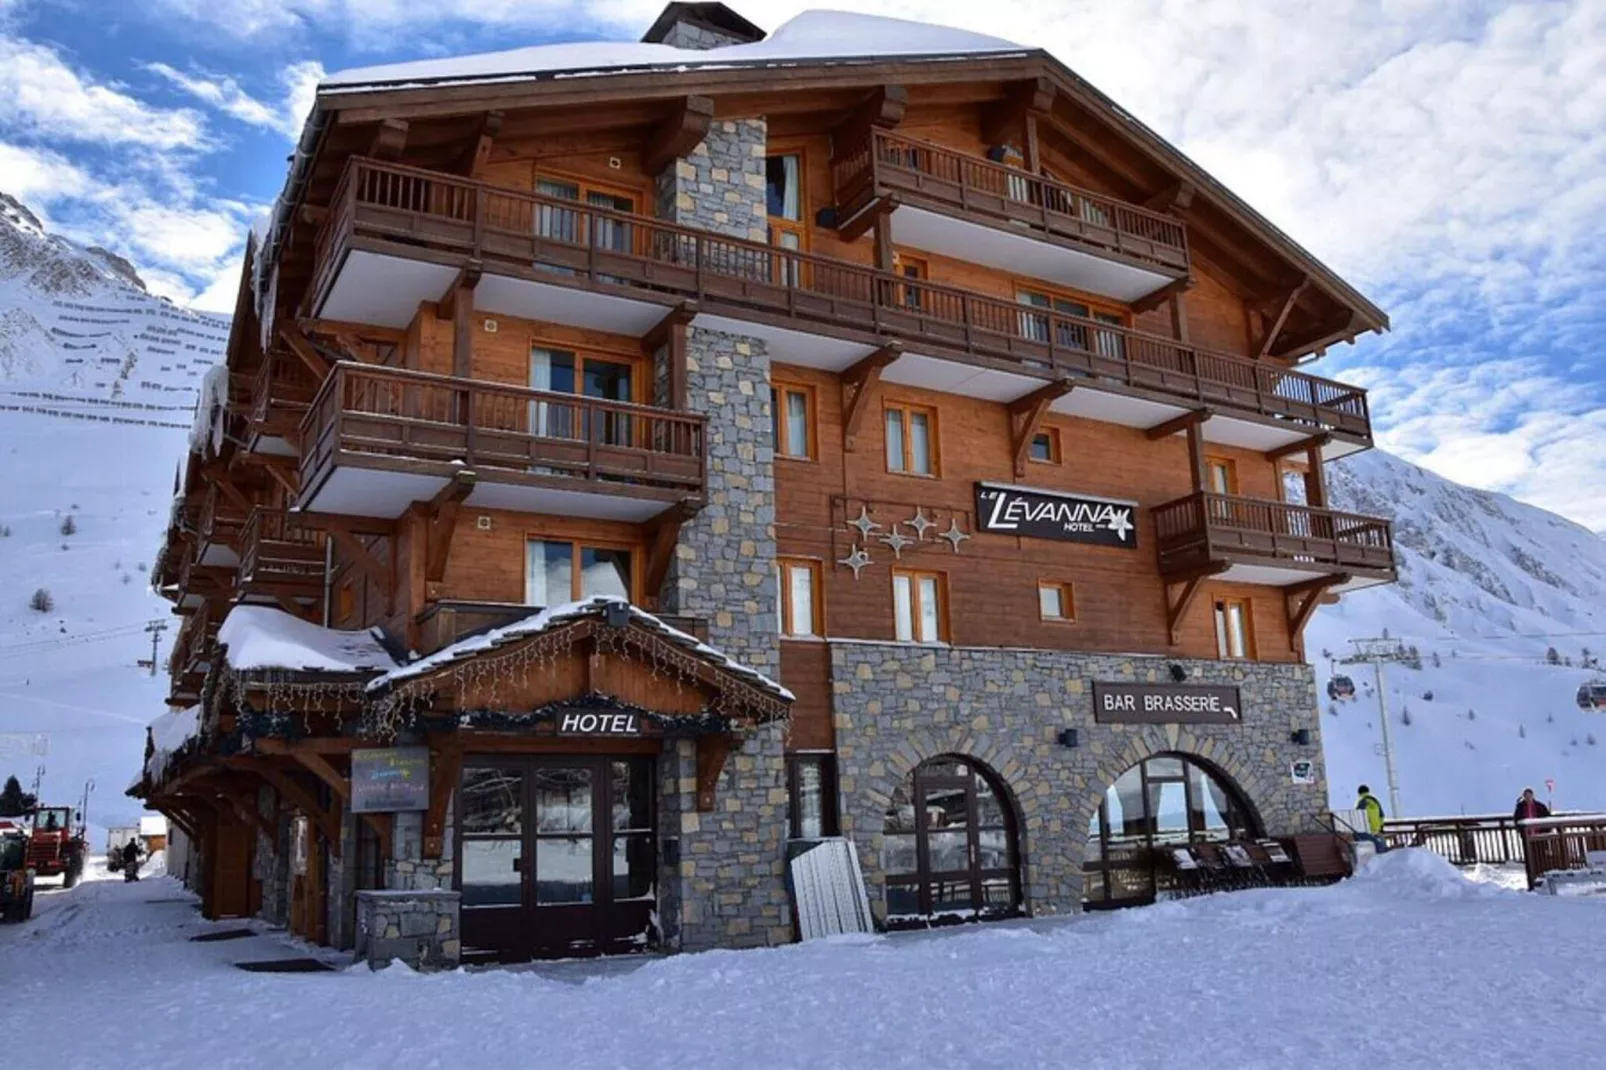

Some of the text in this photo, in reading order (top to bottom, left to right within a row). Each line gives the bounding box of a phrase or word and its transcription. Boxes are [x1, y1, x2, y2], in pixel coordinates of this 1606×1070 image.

[1063, 522, 1095, 533] HOTEL
[1103, 694, 1136, 711] BAR
[561, 714, 638, 732] HOTEL
